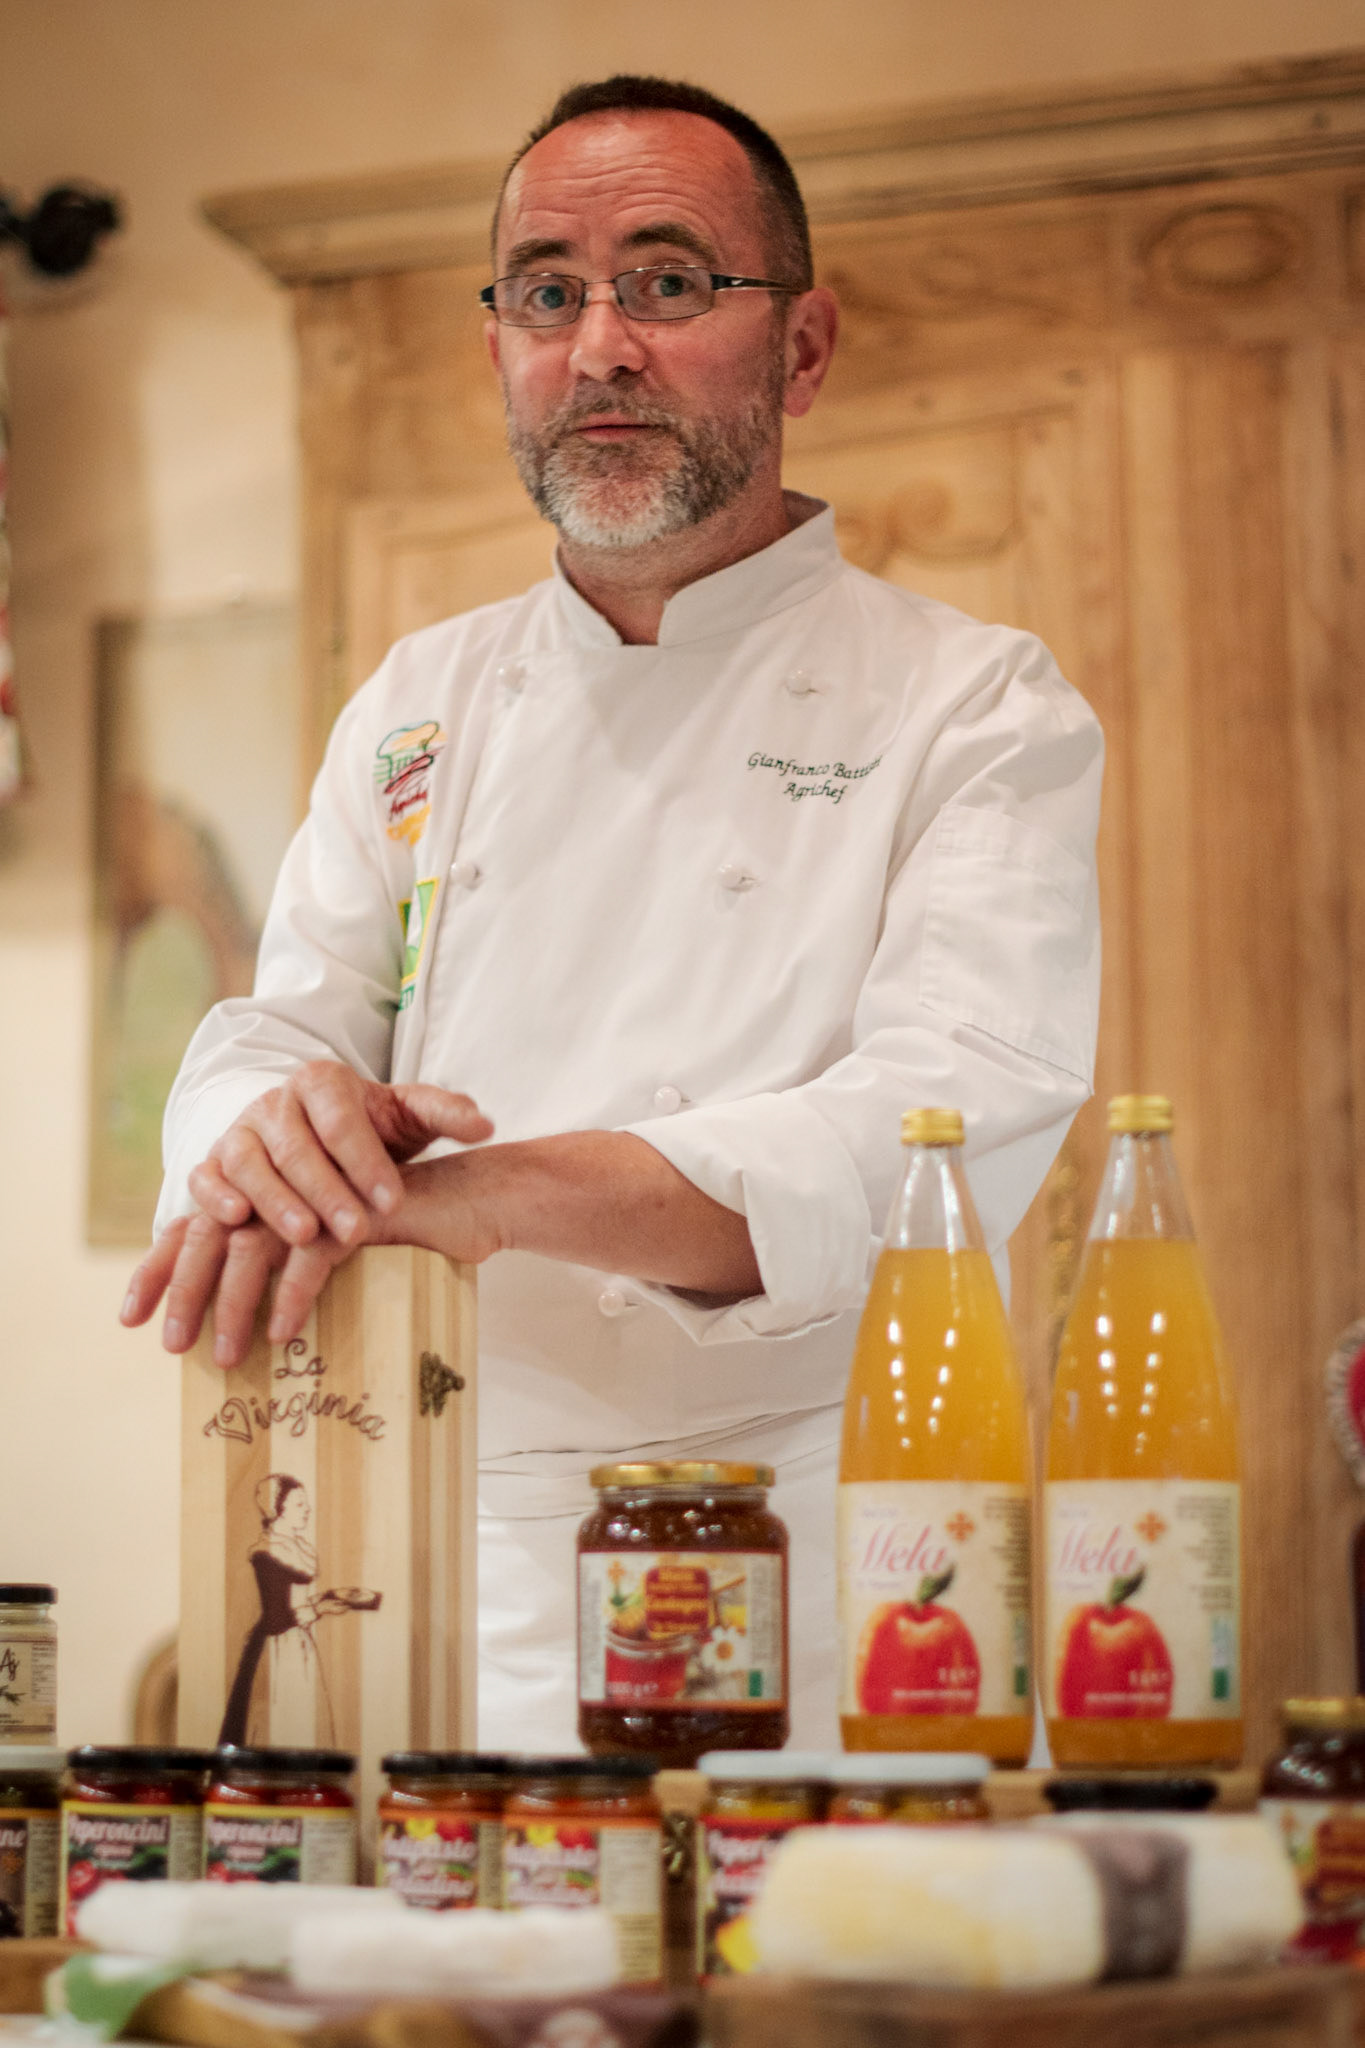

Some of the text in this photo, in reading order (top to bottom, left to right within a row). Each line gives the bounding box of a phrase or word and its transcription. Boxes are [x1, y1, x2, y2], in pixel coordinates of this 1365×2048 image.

[748, 752, 829, 777] Gianfranco
[783, 780, 848, 804] Agrichef
[274, 1338, 328, 1379] La
[203, 1378, 387, 1444] Virginia
